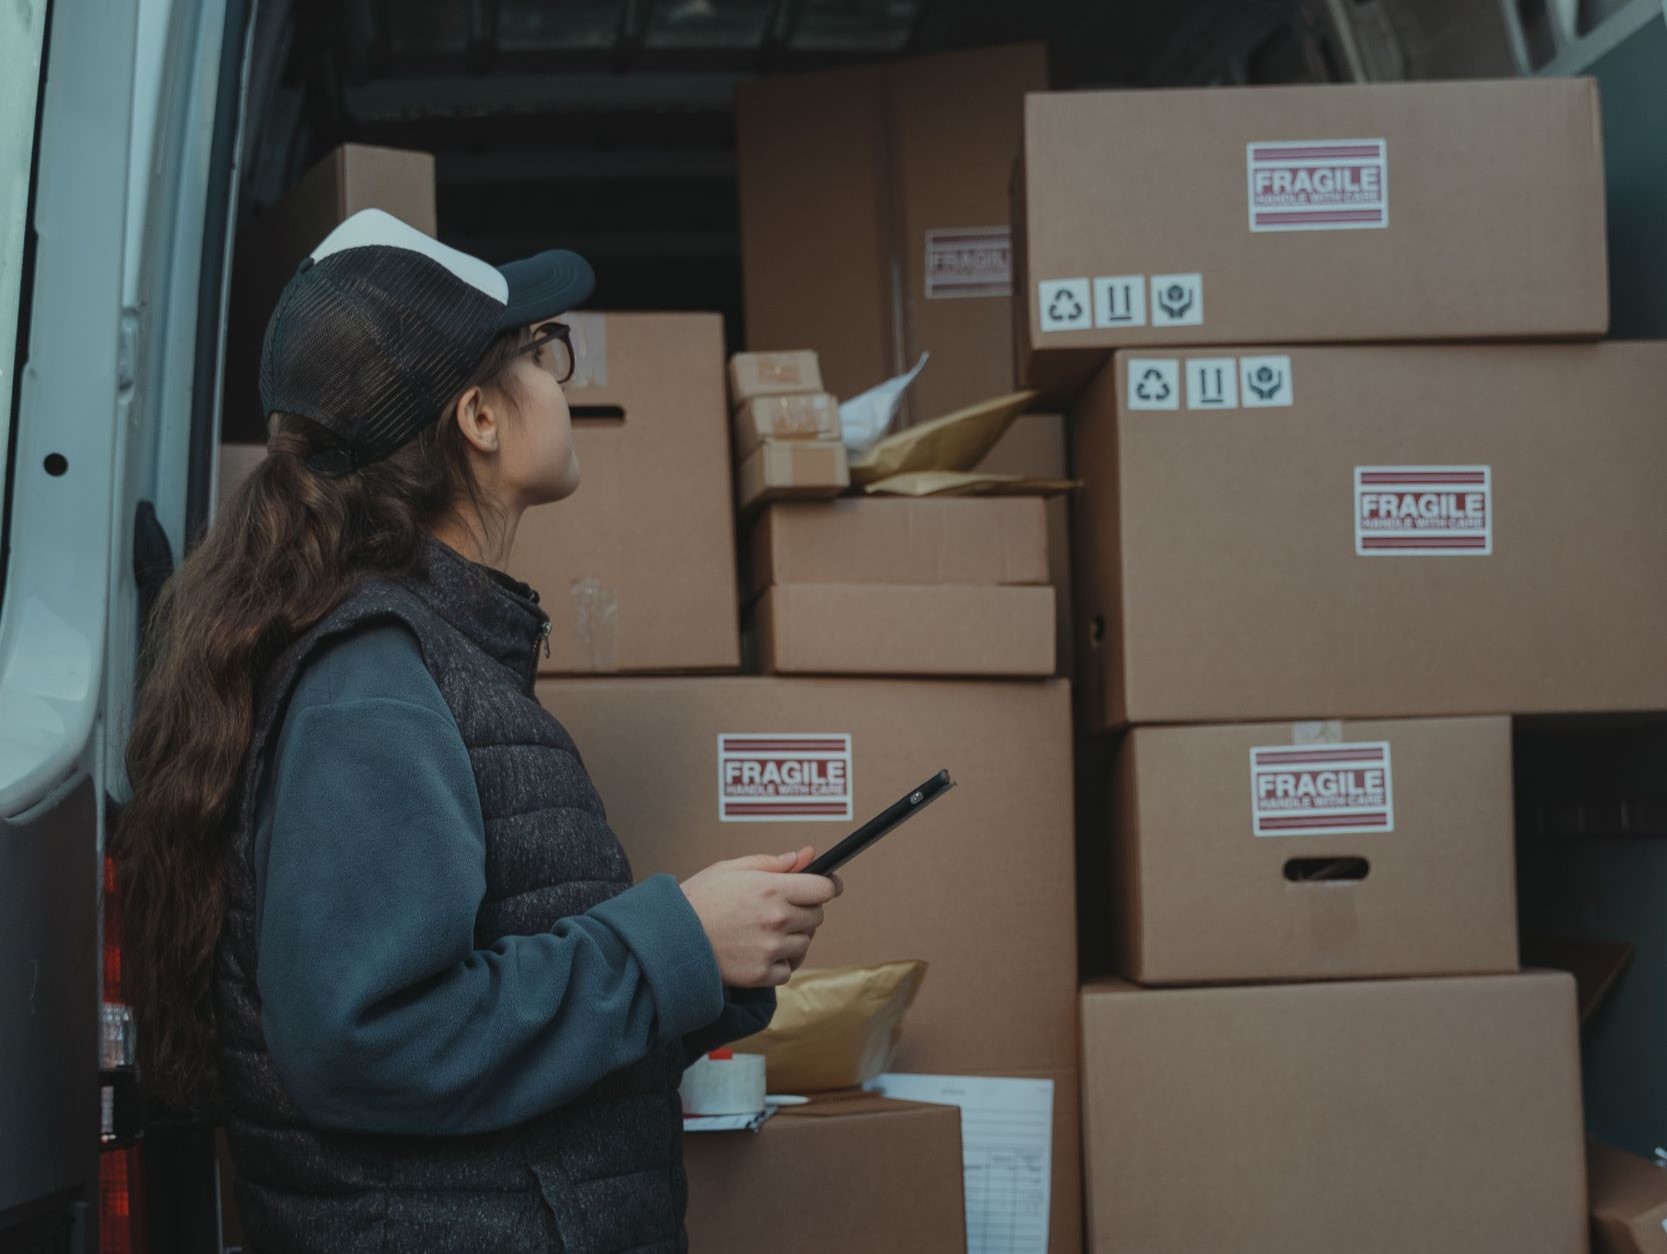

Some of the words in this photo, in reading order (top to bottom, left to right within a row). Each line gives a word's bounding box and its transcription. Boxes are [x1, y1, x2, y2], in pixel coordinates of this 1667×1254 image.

[1255, 167, 1379, 195] FRAGILE
[933, 250, 1009, 271] FRAGIL
[1362, 493, 1484, 519] FRAGILE
[725, 760, 845, 785] FRAGILE
[1258, 769, 1382, 799] FRAGILE
